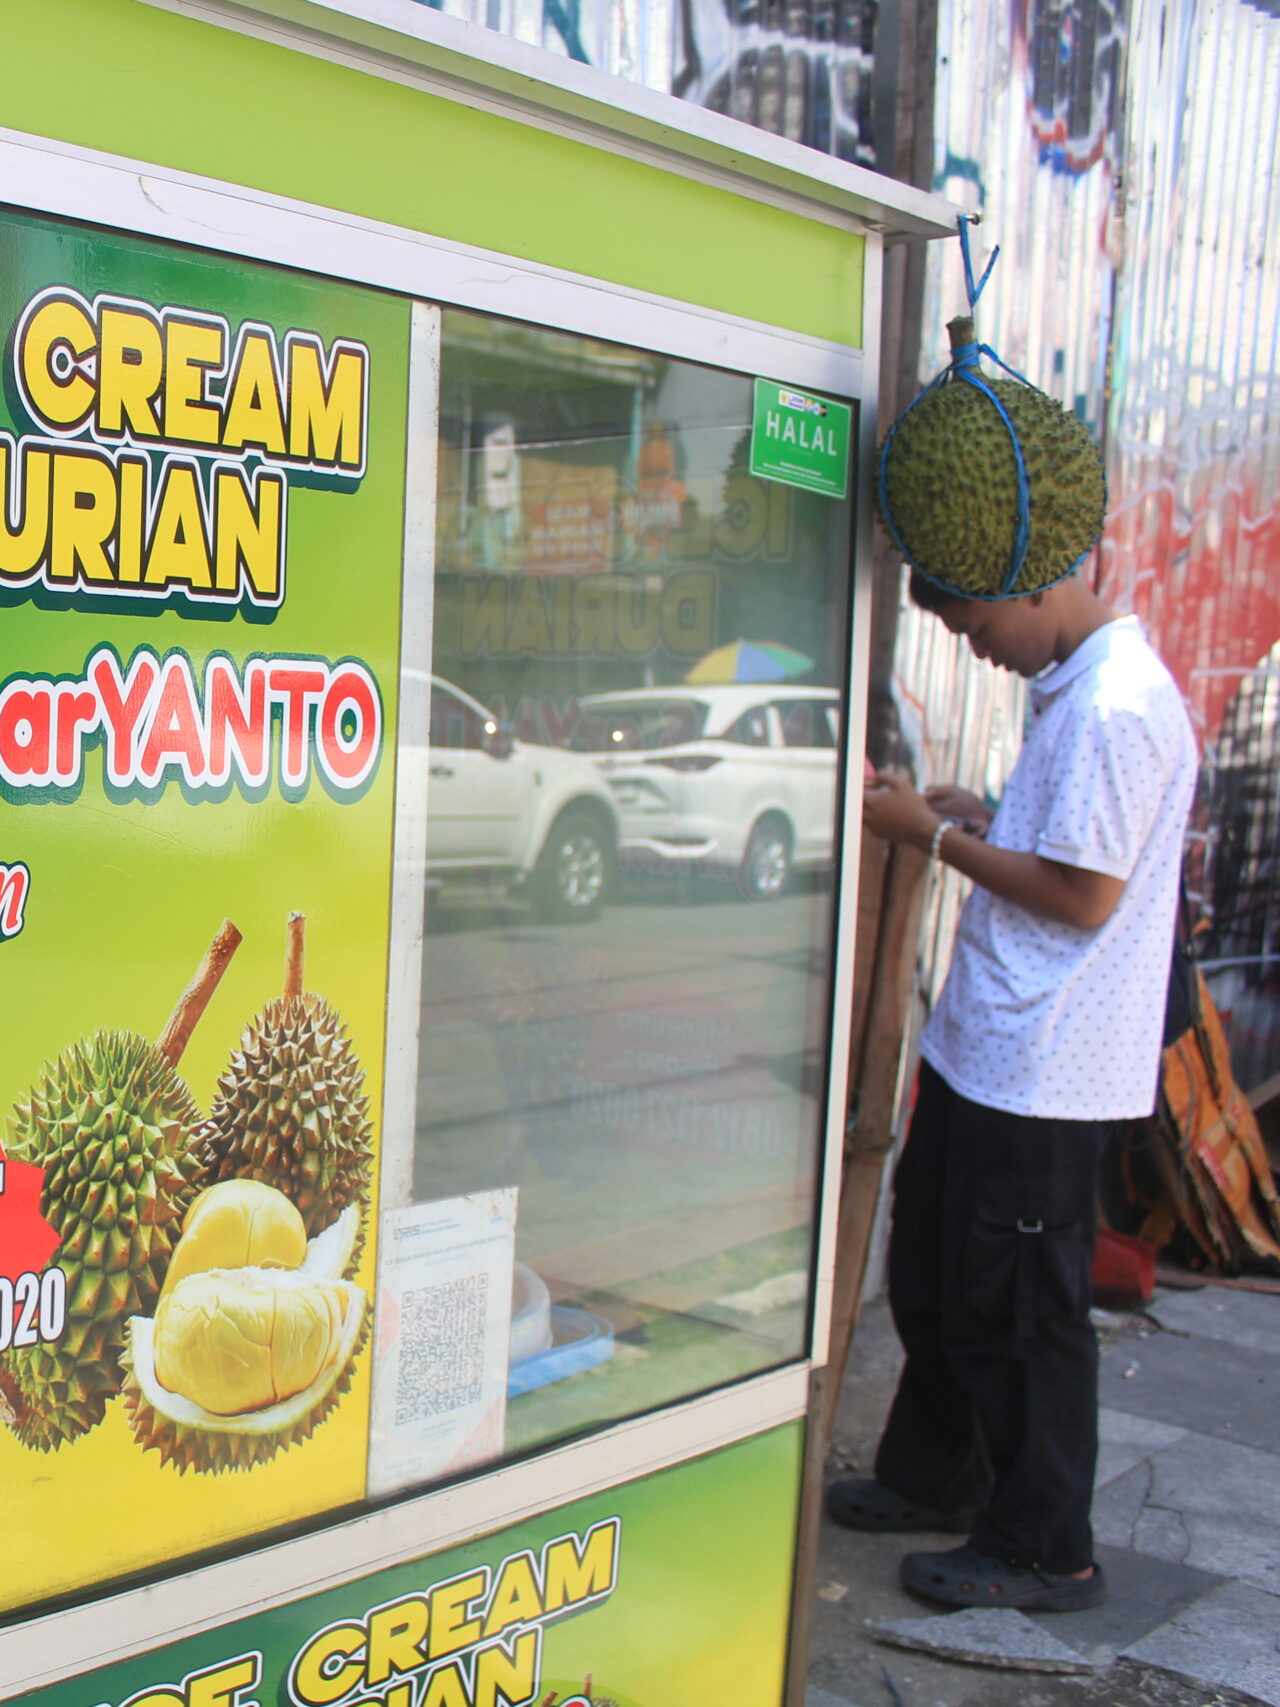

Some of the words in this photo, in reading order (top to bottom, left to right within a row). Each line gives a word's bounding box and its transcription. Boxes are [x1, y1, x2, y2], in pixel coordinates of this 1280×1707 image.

[14, 285, 370, 478] CREAM
[765, 410, 837, 457] HALAL
[288, 1516, 621, 1707] CREAM
